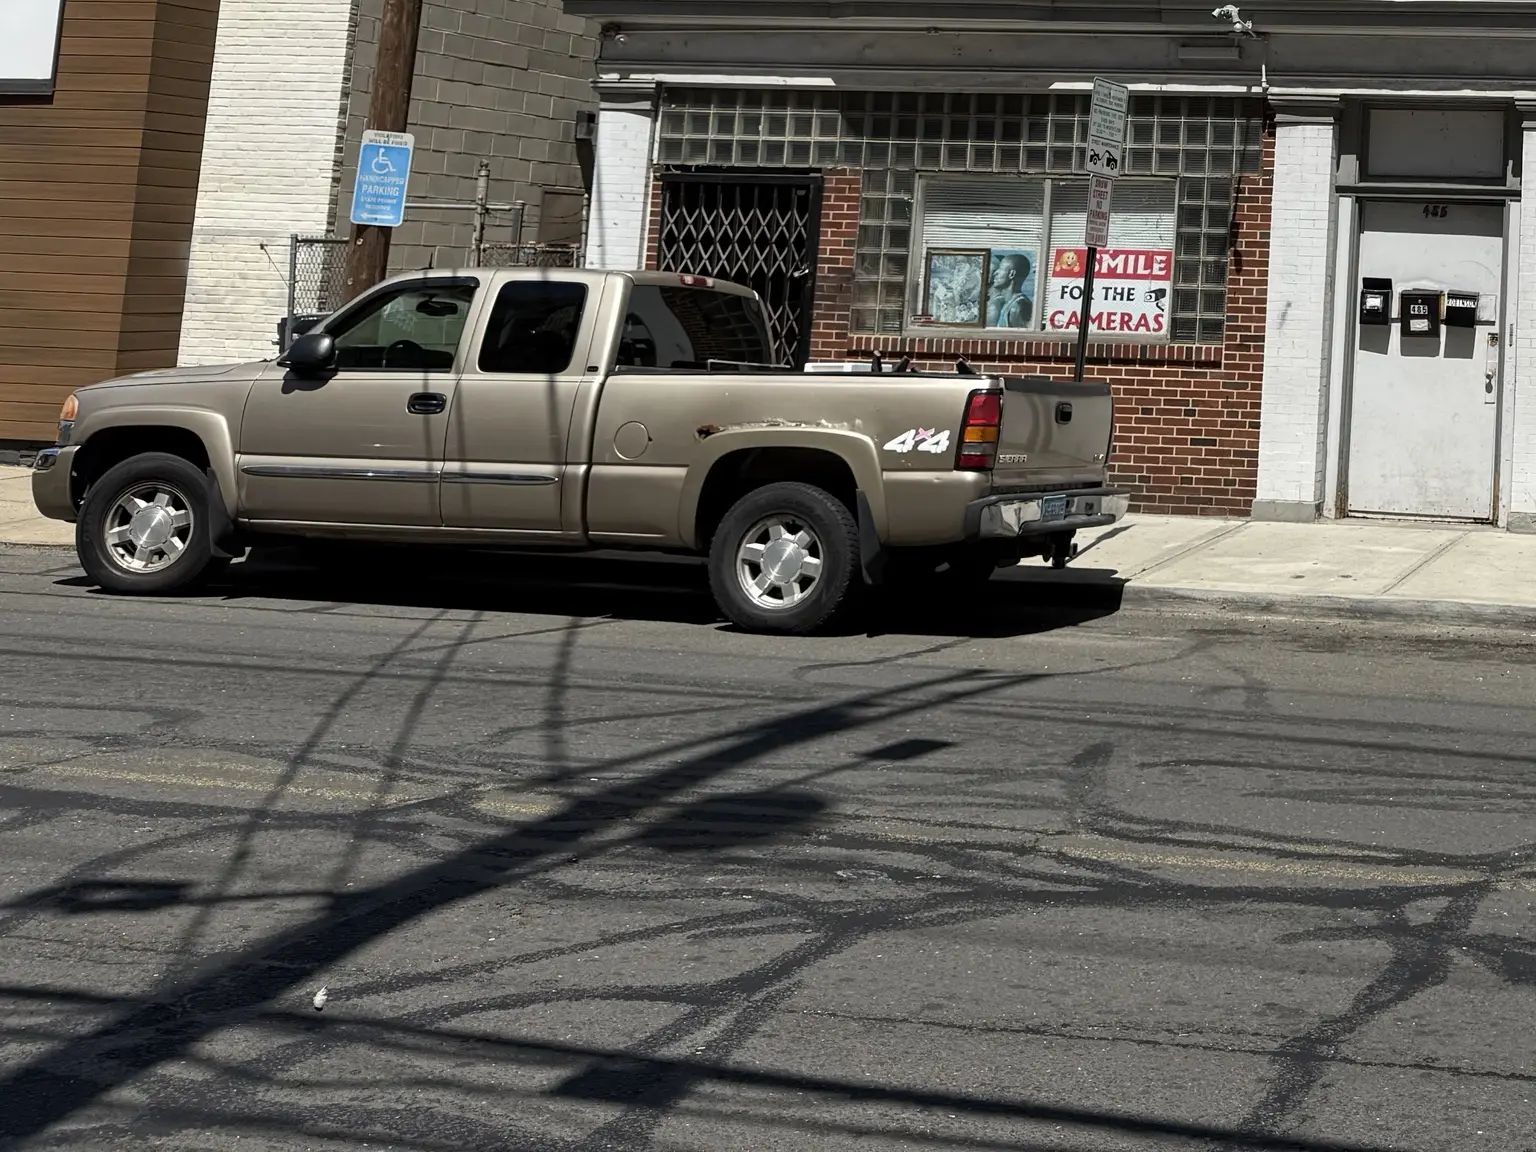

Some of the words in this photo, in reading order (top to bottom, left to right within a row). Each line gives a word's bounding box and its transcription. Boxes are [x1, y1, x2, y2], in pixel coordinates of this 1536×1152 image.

[361, 184, 400, 196] PARKING
[1060, 285, 1094, 300] FO
[1102, 286, 1136, 302] THE
[1411, 304, 1428, 314] 485
[1049, 310, 1164, 332] CAMERAS
[998, 454, 1028, 463] SIERRA
